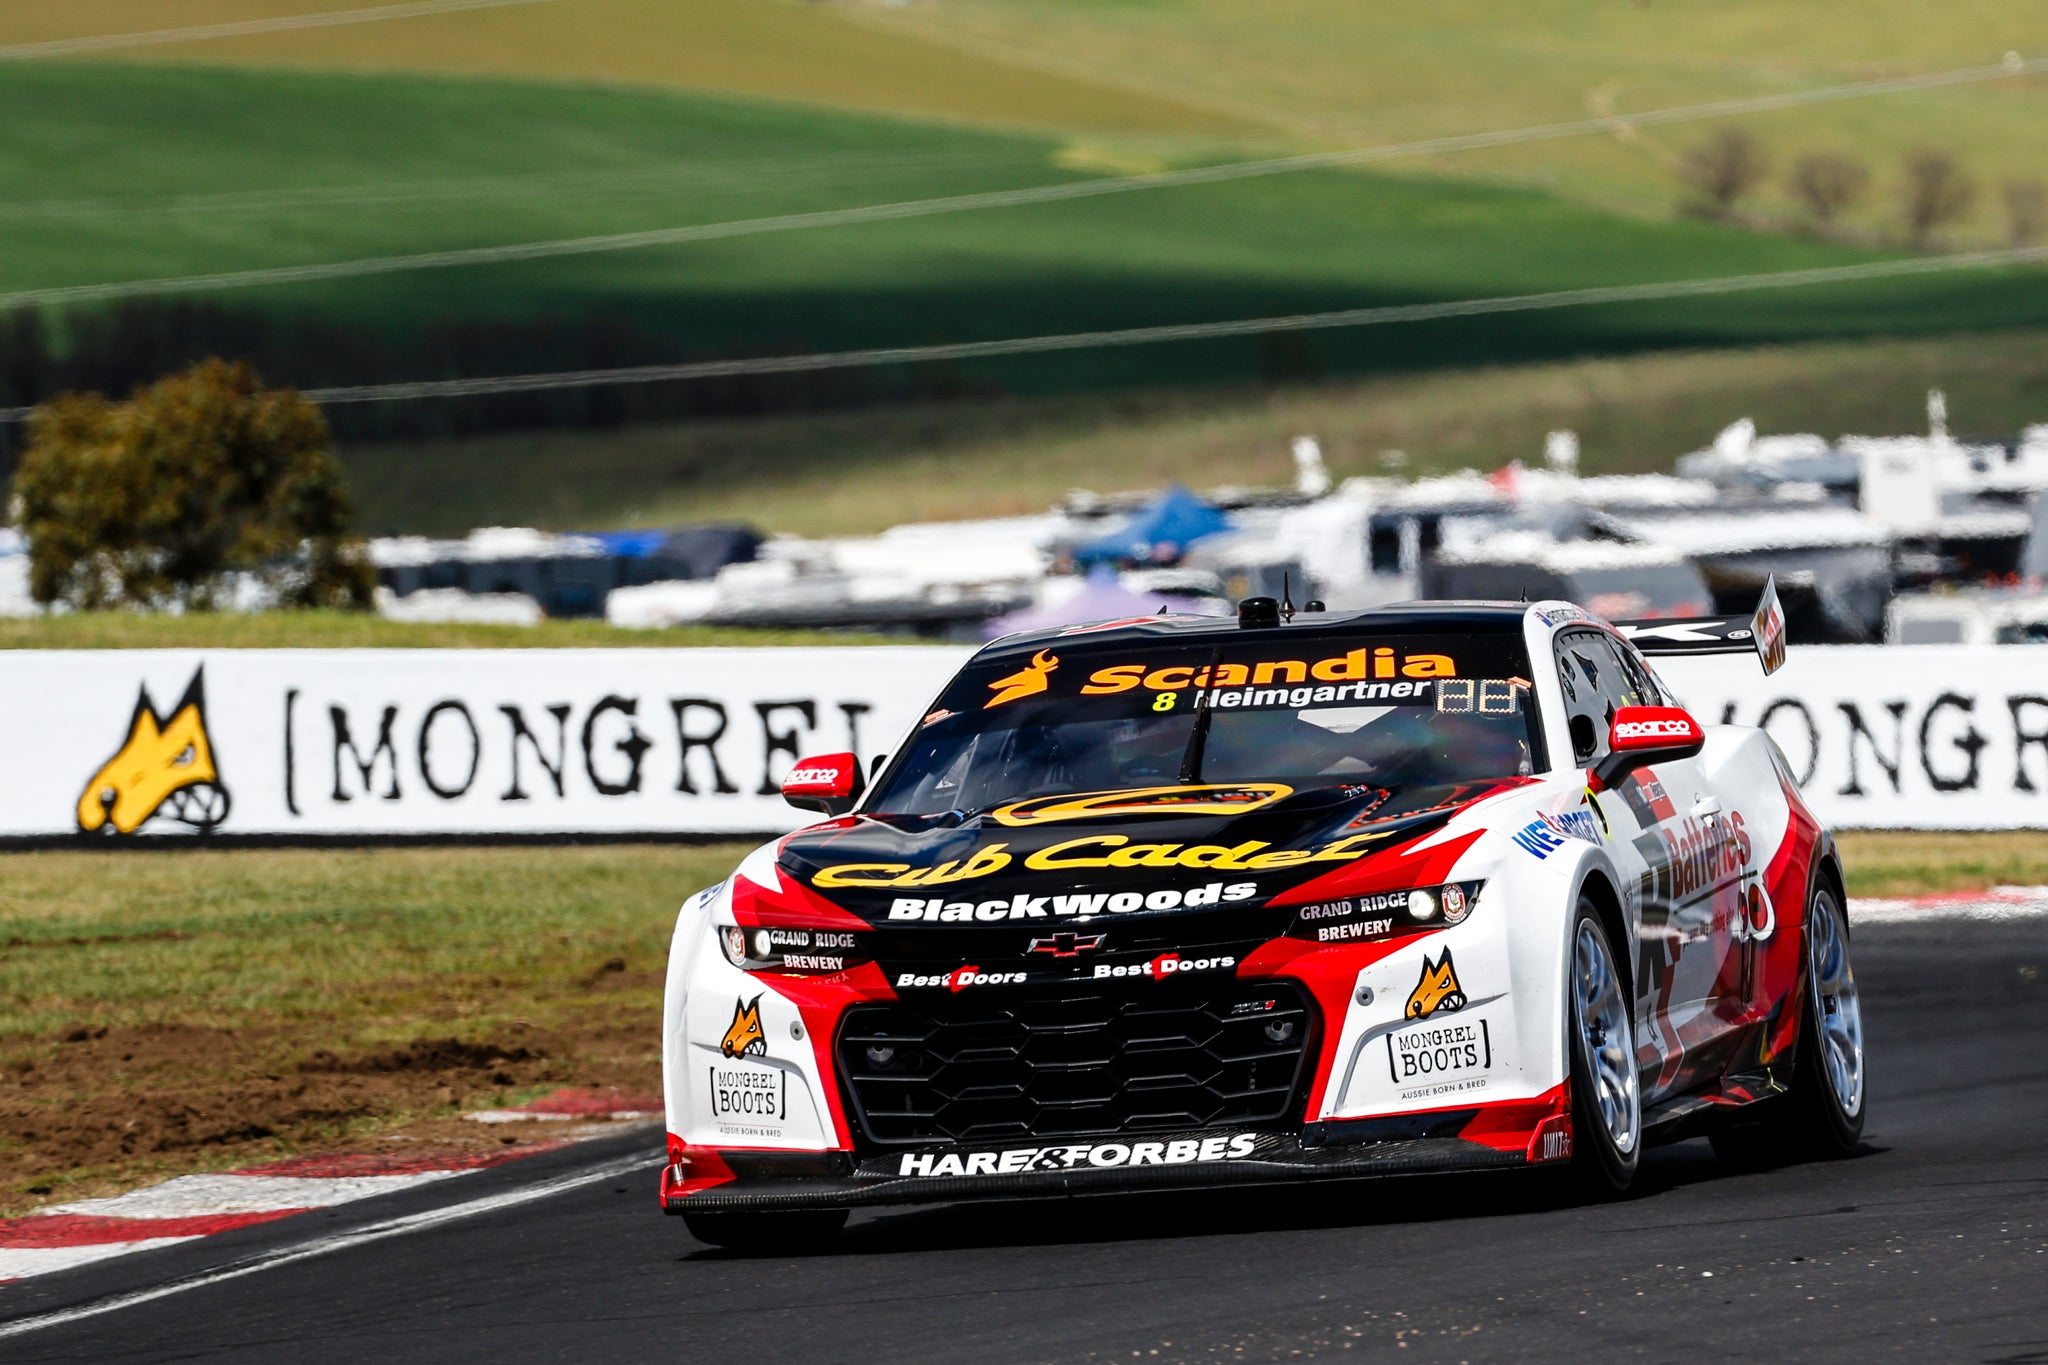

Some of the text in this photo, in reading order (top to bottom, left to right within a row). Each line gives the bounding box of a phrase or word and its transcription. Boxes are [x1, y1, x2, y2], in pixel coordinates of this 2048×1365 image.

[1080, 647, 1457, 694] Scandia
[1152, 679, 1431, 711] 8 Heimgartner
[1615, 720, 1690, 738] sparco
[811, 830, 1398, 888] Cub Cadet
[888, 882, 1258, 922] Blackwoods
[1300, 892, 1408, 920] GRAND RIDGE
[771, 930, 856, 948] GRAND RIDGE
[1318, 918, 1393, 942] BREWERY
[783, 954, 843, 970] BREWERY
[1093, 955, 1236, 979] Best Doors
[956, 970, 1028, 986] Doors
[1398, 1026, 1476, 1051] MONGREL
[1401, 1044, 1477, 1076] BOOTS
[718, 1071, 776, 1089] MONGREL
[1401, 1087, 1430, 1100] AUSSIE
[1432, 1084, 1456, 1096] BORN
[1466, 1080, 1486, 1090] BRED
[719, 1089, 776, 1115] BOOTS
